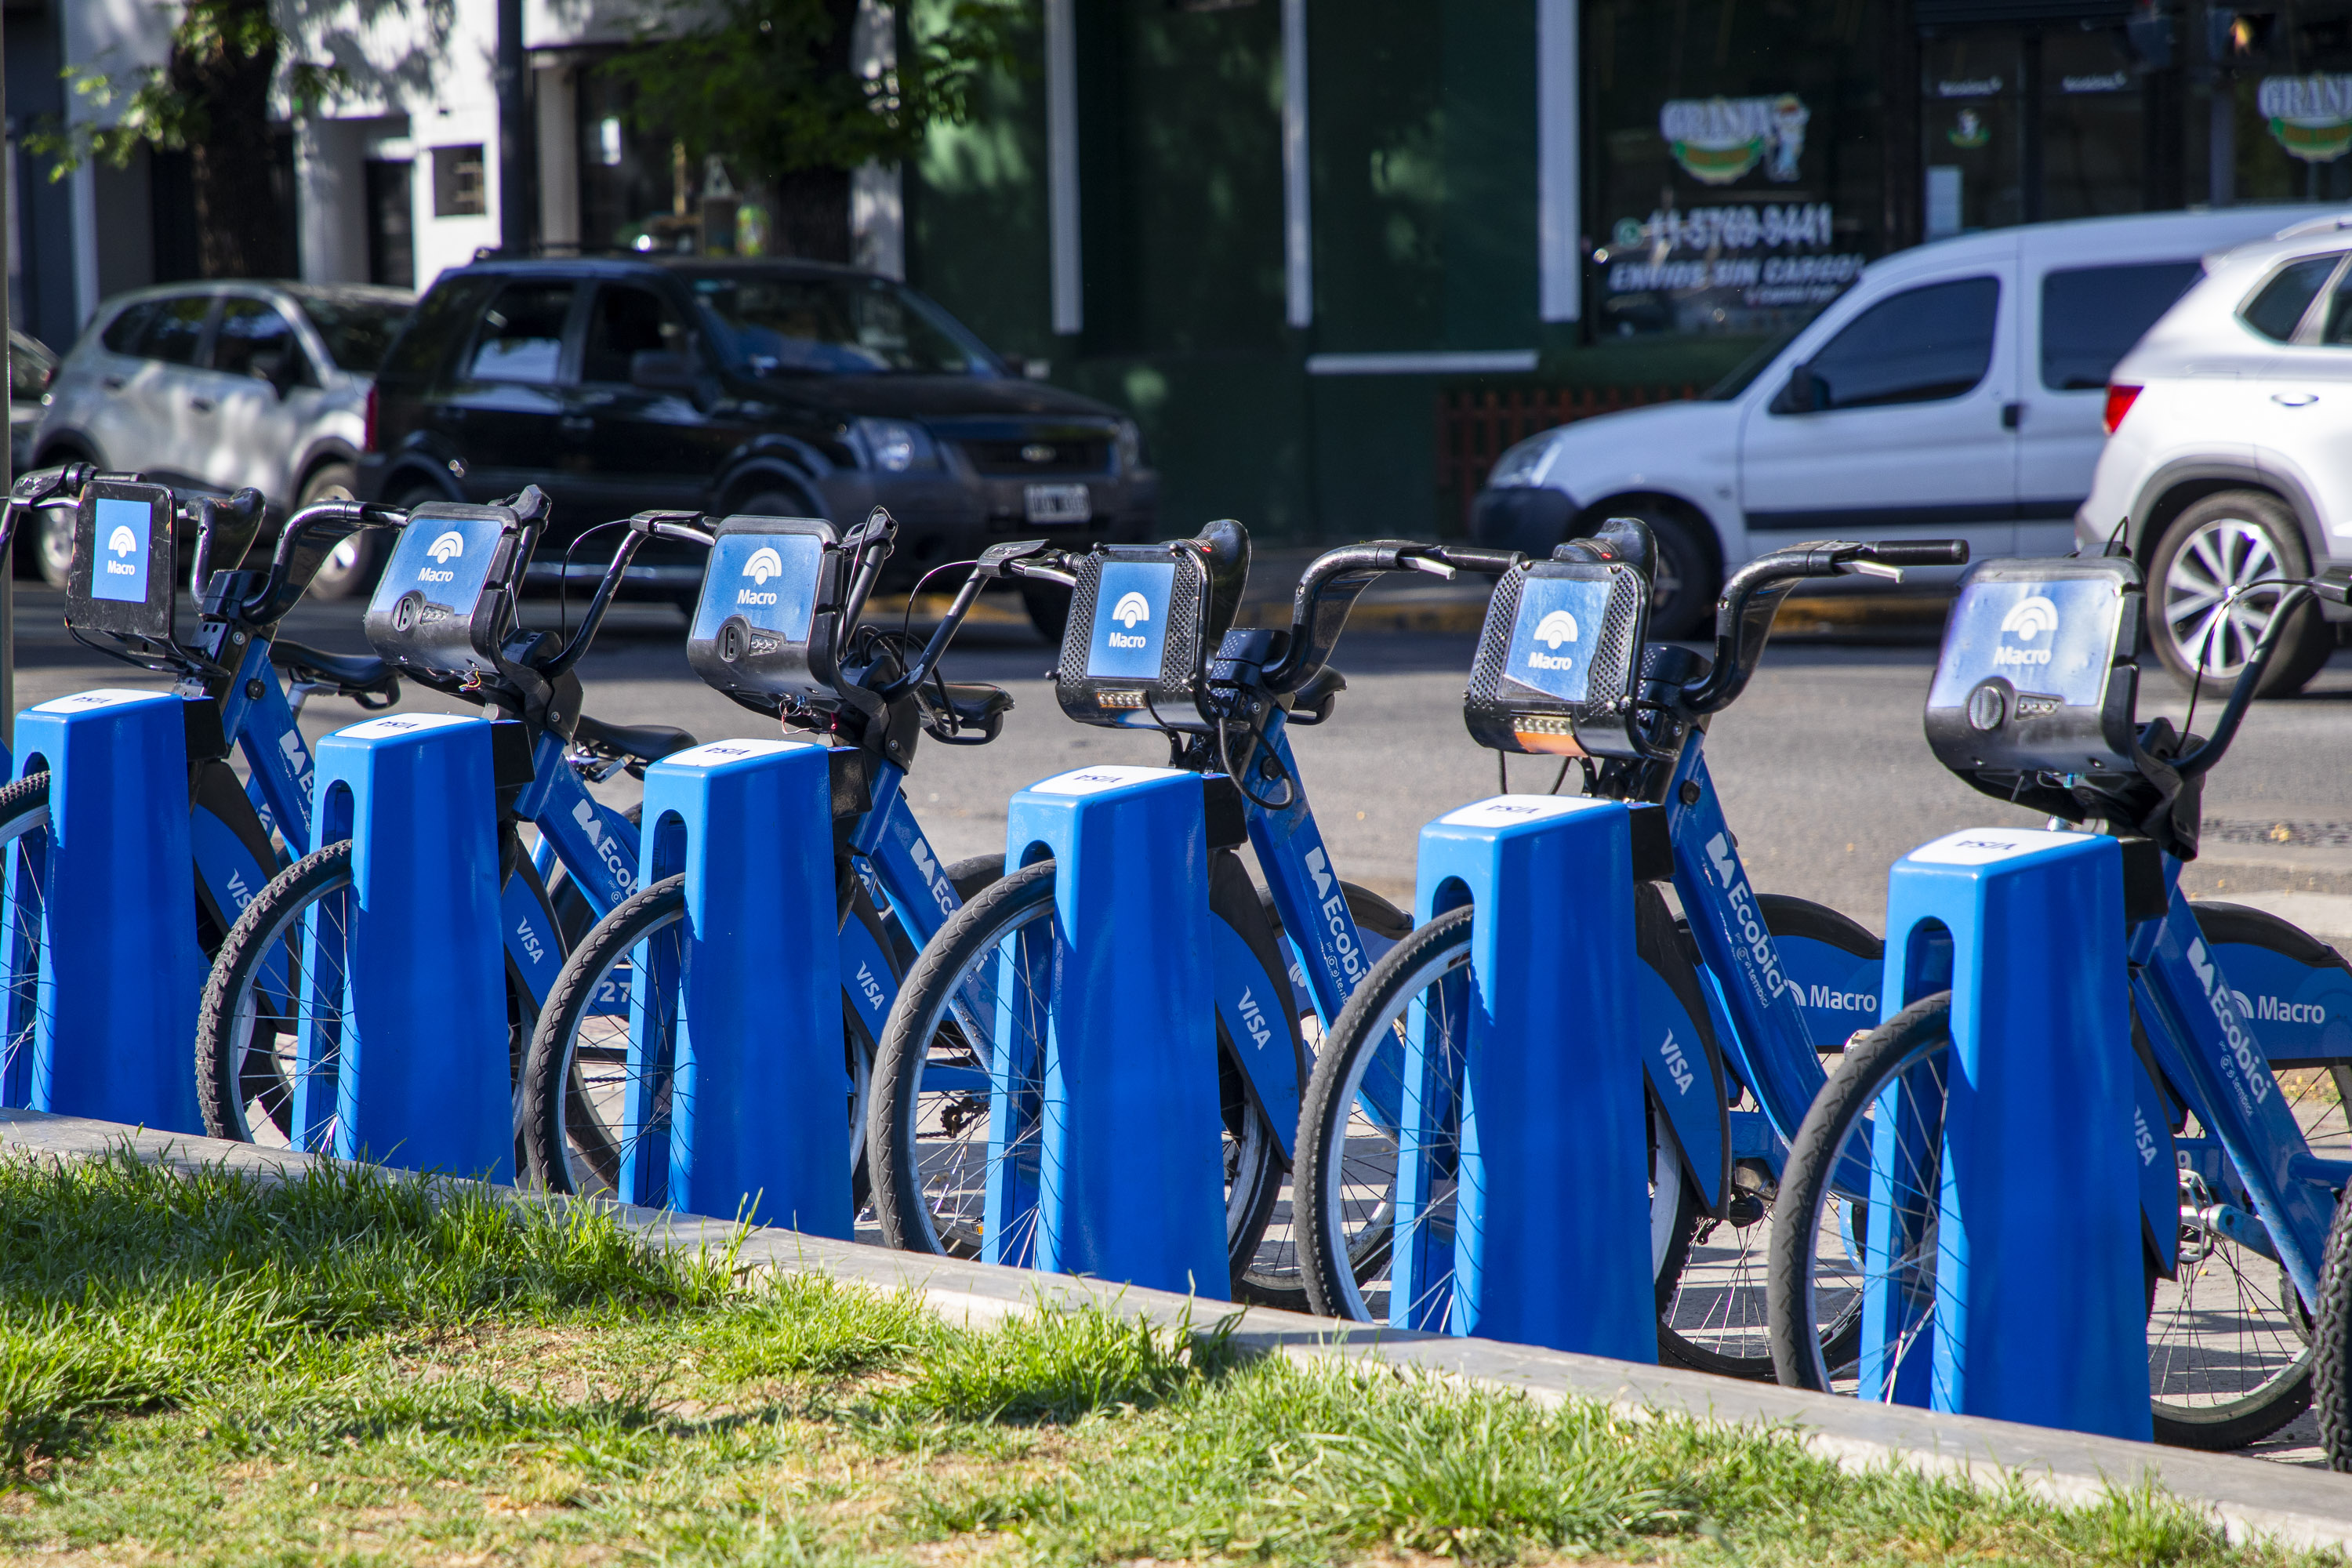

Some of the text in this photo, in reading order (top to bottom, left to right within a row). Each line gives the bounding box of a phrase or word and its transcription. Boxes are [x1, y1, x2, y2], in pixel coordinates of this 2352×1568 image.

[107, 560, 135, 575] Macro
[417, 567, 454, 582] Macro
[737, 589, 778, 605] Macro
[1109, 632, 1146, 648] Macro
[1993, 646, 2052, 666] Macro
[1528, 652, 1572, 670] Macro
[597, 836, 640, 898] Ecob
[227, 867, 254, 913] VIS
[517, 915, 544, 965] VISA
[1322, 895, 1367, 984] Ecobi
[1326, 941, 1334, 953] por
[1727, 880, 1788, 999] Ecobici
[855, 960, 885, 1011] VISA
[1809, 985, 1878, 1012] Macro
[1238, 985, 1272, 1051] VISA
[2257, 995, 2326, 1025] Macro
[1660, 1027, 1694, 1096] VISA
[2210, 984, 2272, 1105] Ecobici
